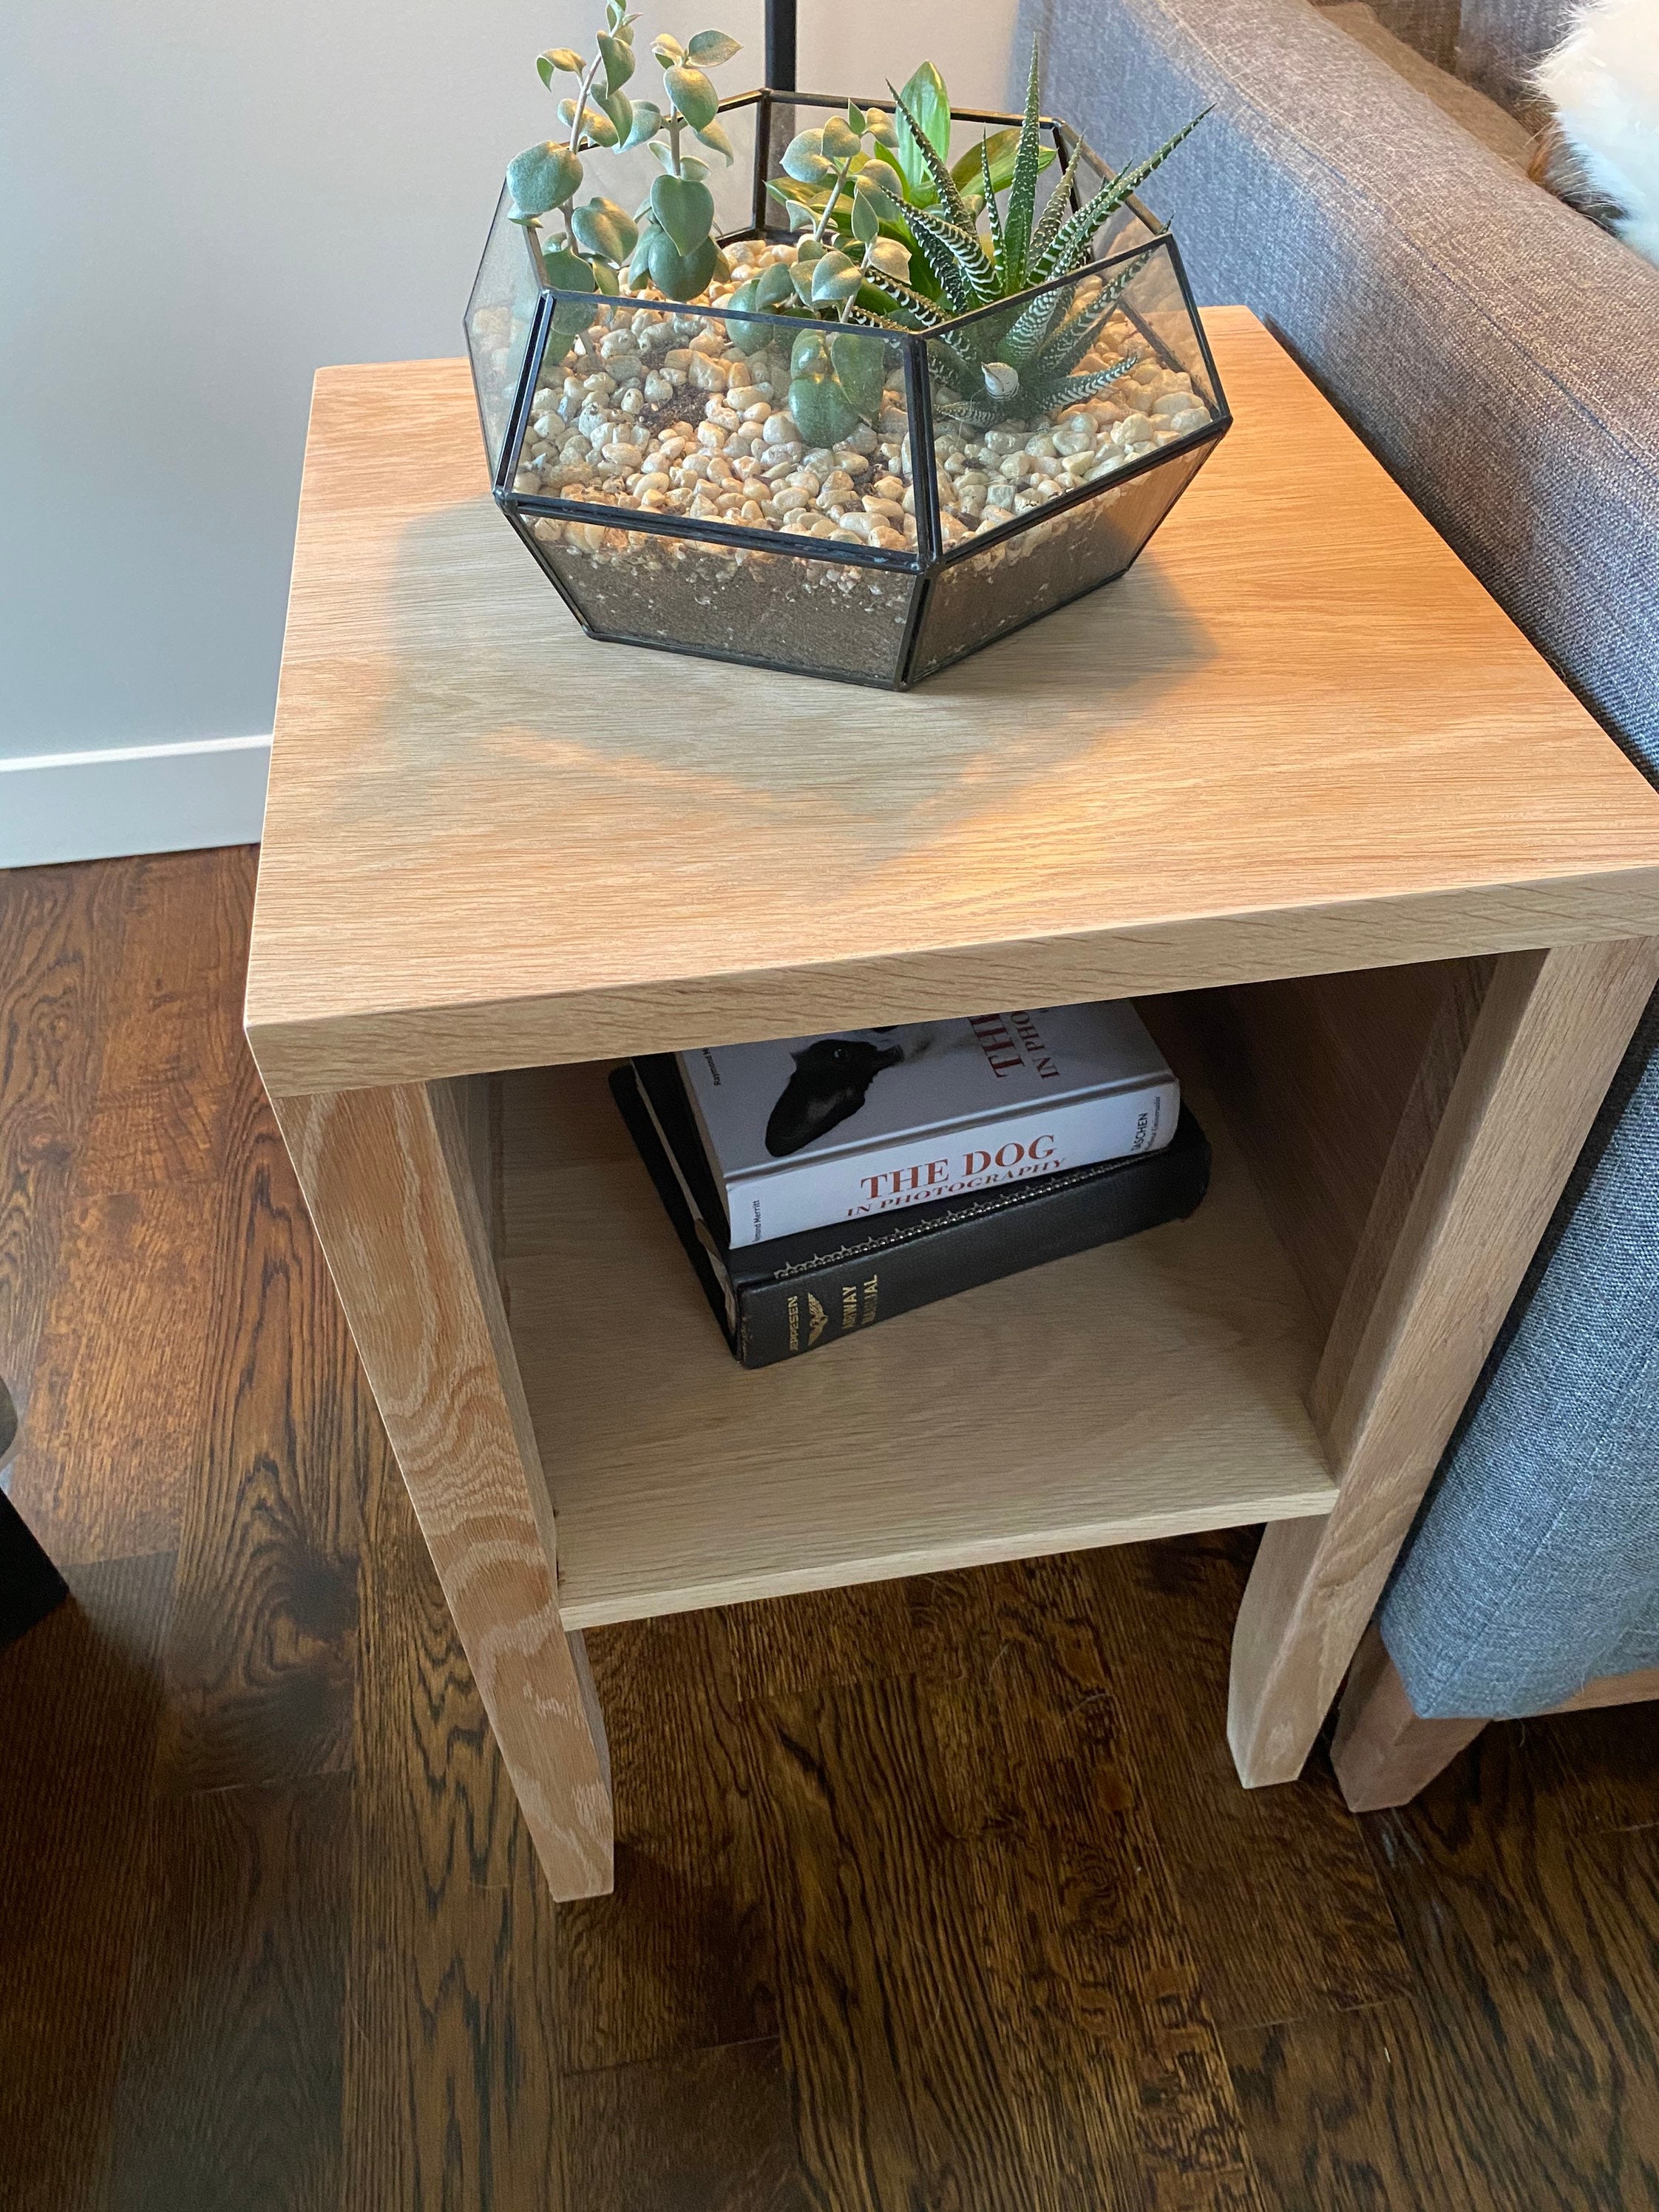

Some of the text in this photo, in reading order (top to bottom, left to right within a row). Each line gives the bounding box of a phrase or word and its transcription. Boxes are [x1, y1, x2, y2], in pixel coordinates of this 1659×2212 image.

[1032, 1057, 1060, 1079] IN
[1130, 1112, 1148, 1151] TASCHEN
[847, 1158, 1066, 1217] IN PHOTOGRAPHY
[861, 1134, 1058, 1200] THE DOG
[753, 1199, 761, 1224] Merritt
[842, 1286, 858, 1329] AIRWAY
